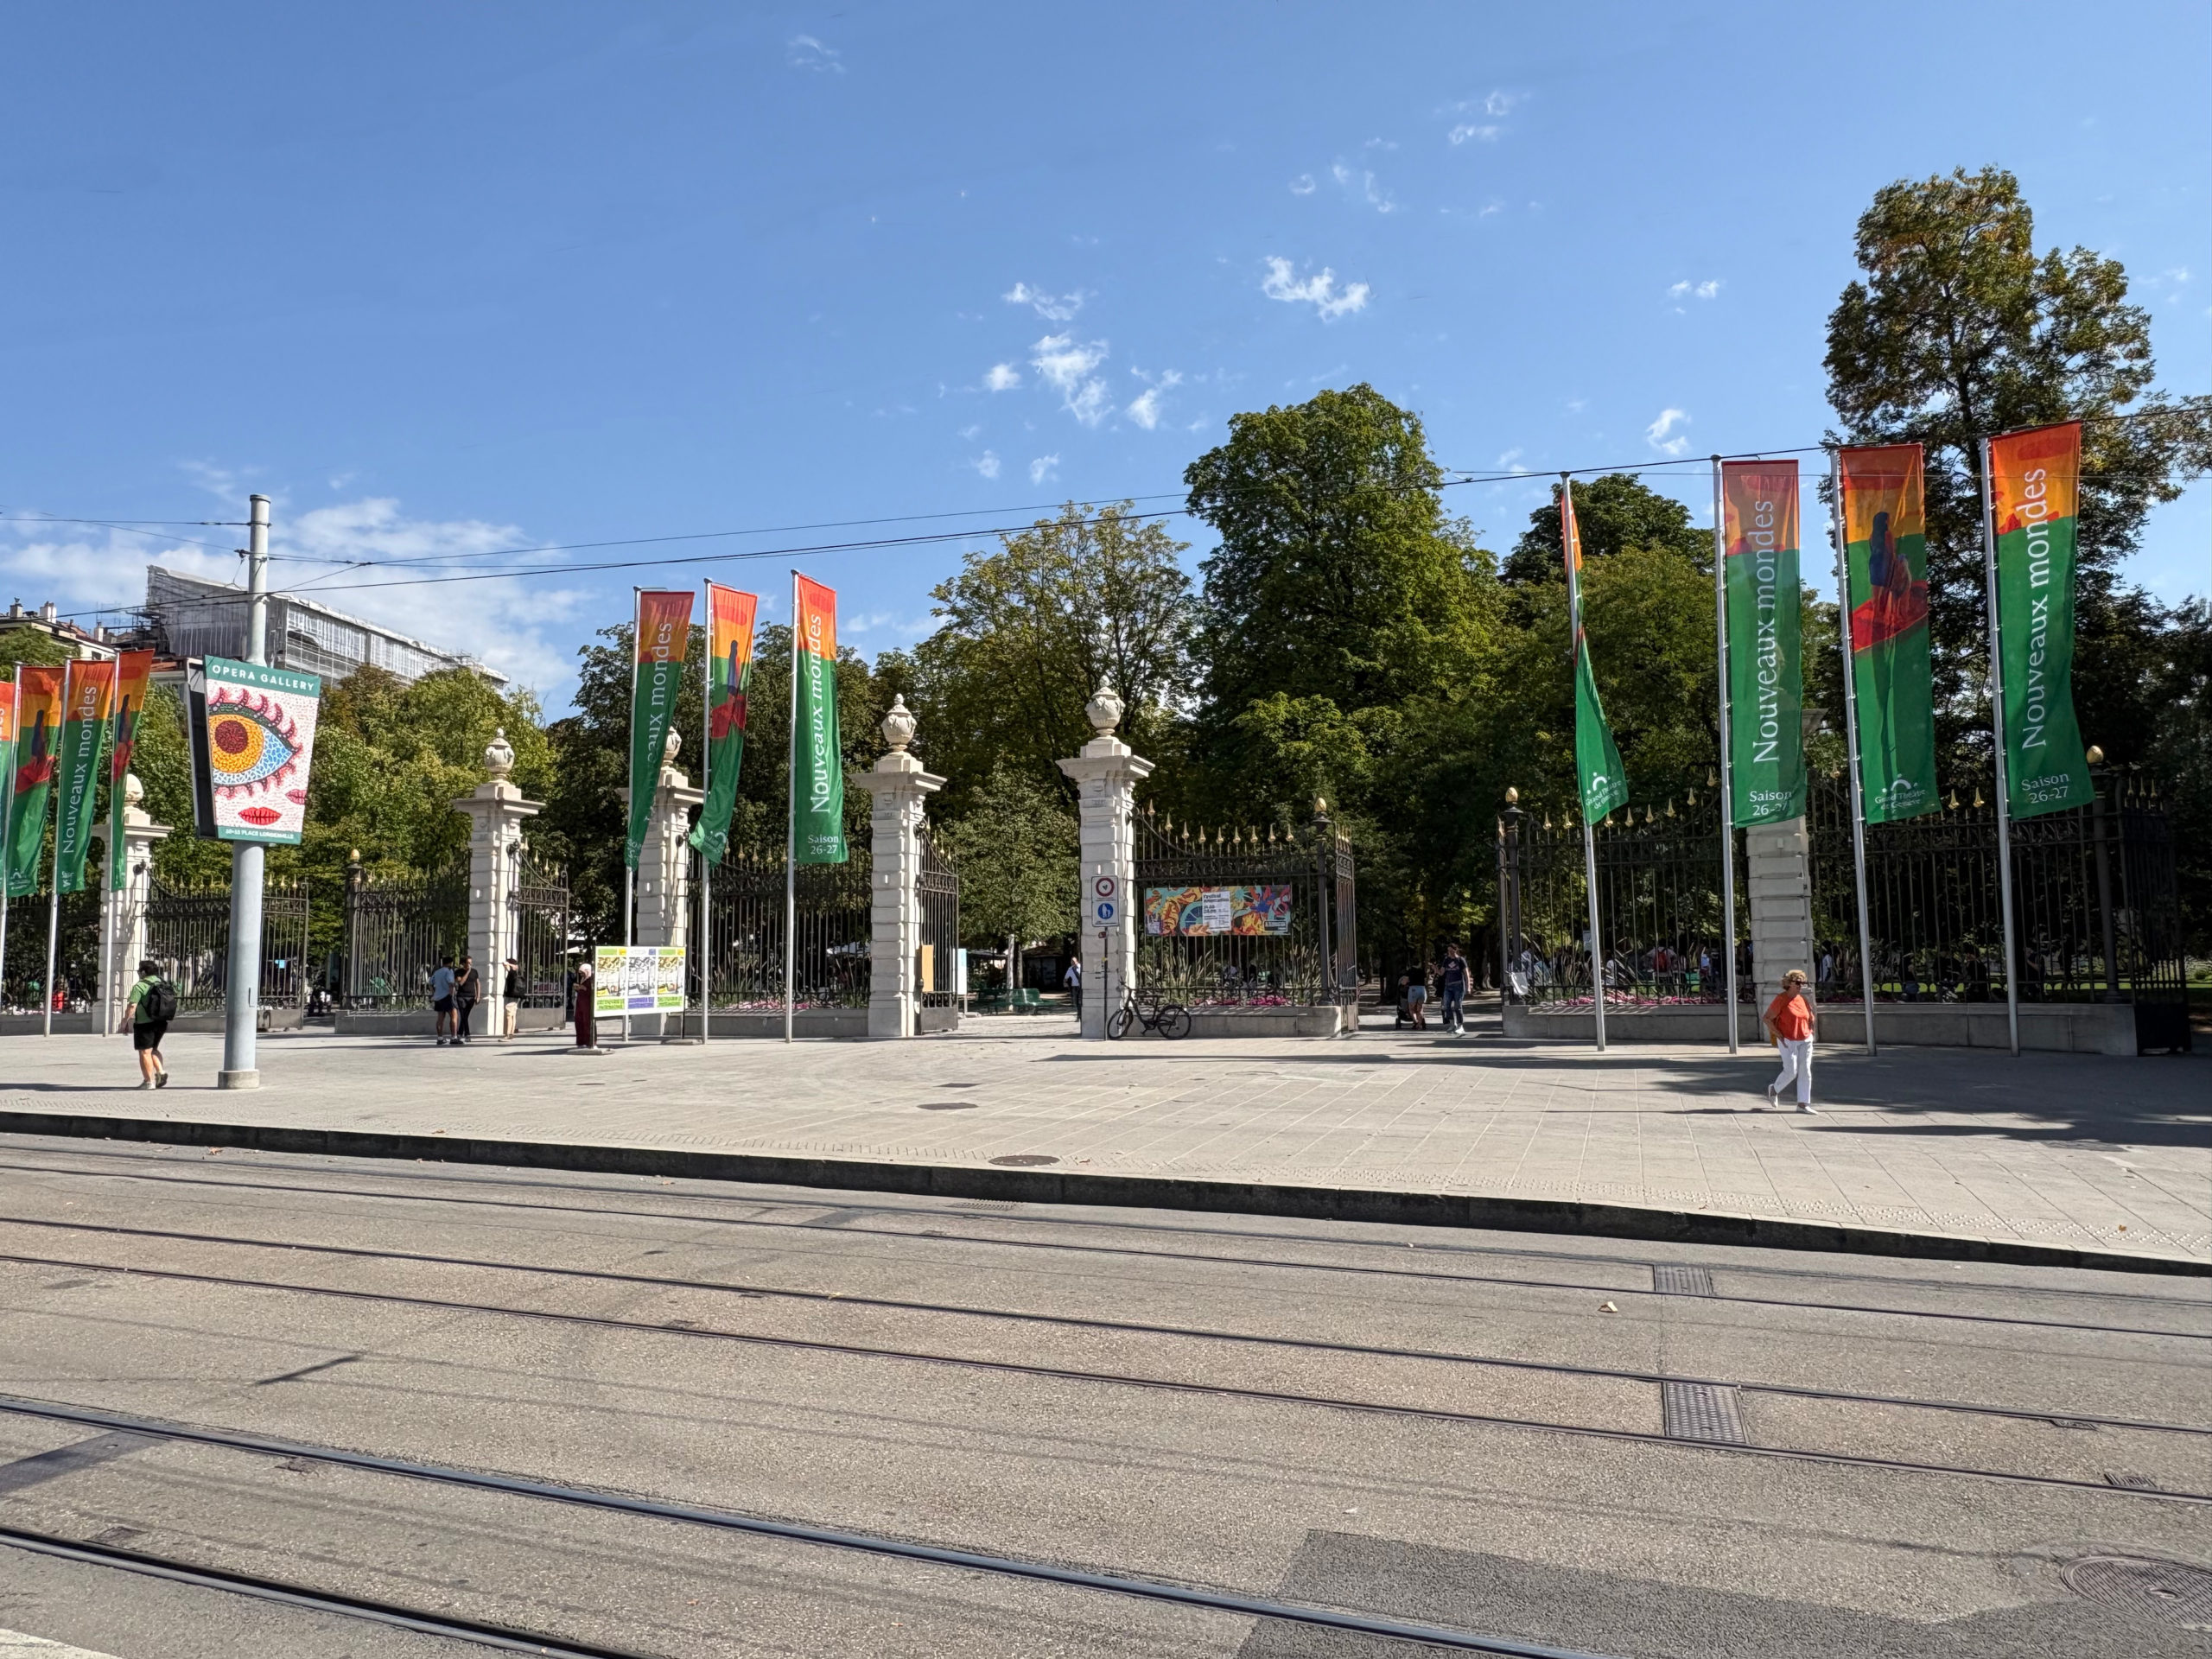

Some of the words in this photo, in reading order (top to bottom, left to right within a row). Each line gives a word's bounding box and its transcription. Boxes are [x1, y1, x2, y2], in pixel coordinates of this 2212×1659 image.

[1747, 500, 1776, 610] mondes
[2016, 468, 2050, 589] mondes
[212, 664, 256, 681] OPERA
[260, 673, 315, 690] GALLERY
[651, 622, 672, 706] mondes
[808, 614, 823, 700] mondes
[1752, 618, 1780, 764] Nouveaux
[2022, 594, 2048, 750] Nouveaux
[62, 762, 88, 854] Nouveaux
[78, 685, 97, 758] mondes
[810, 705, 830, 813] Nouveaux
[1749, 790, 1792, 803] Saison
[2021, 773, 2069, 791] Saison
[2028, 785, 2068, 804] 26-27
[807, 834, 839, 844] Saison
[810, 844, 838, 855] 26-27
